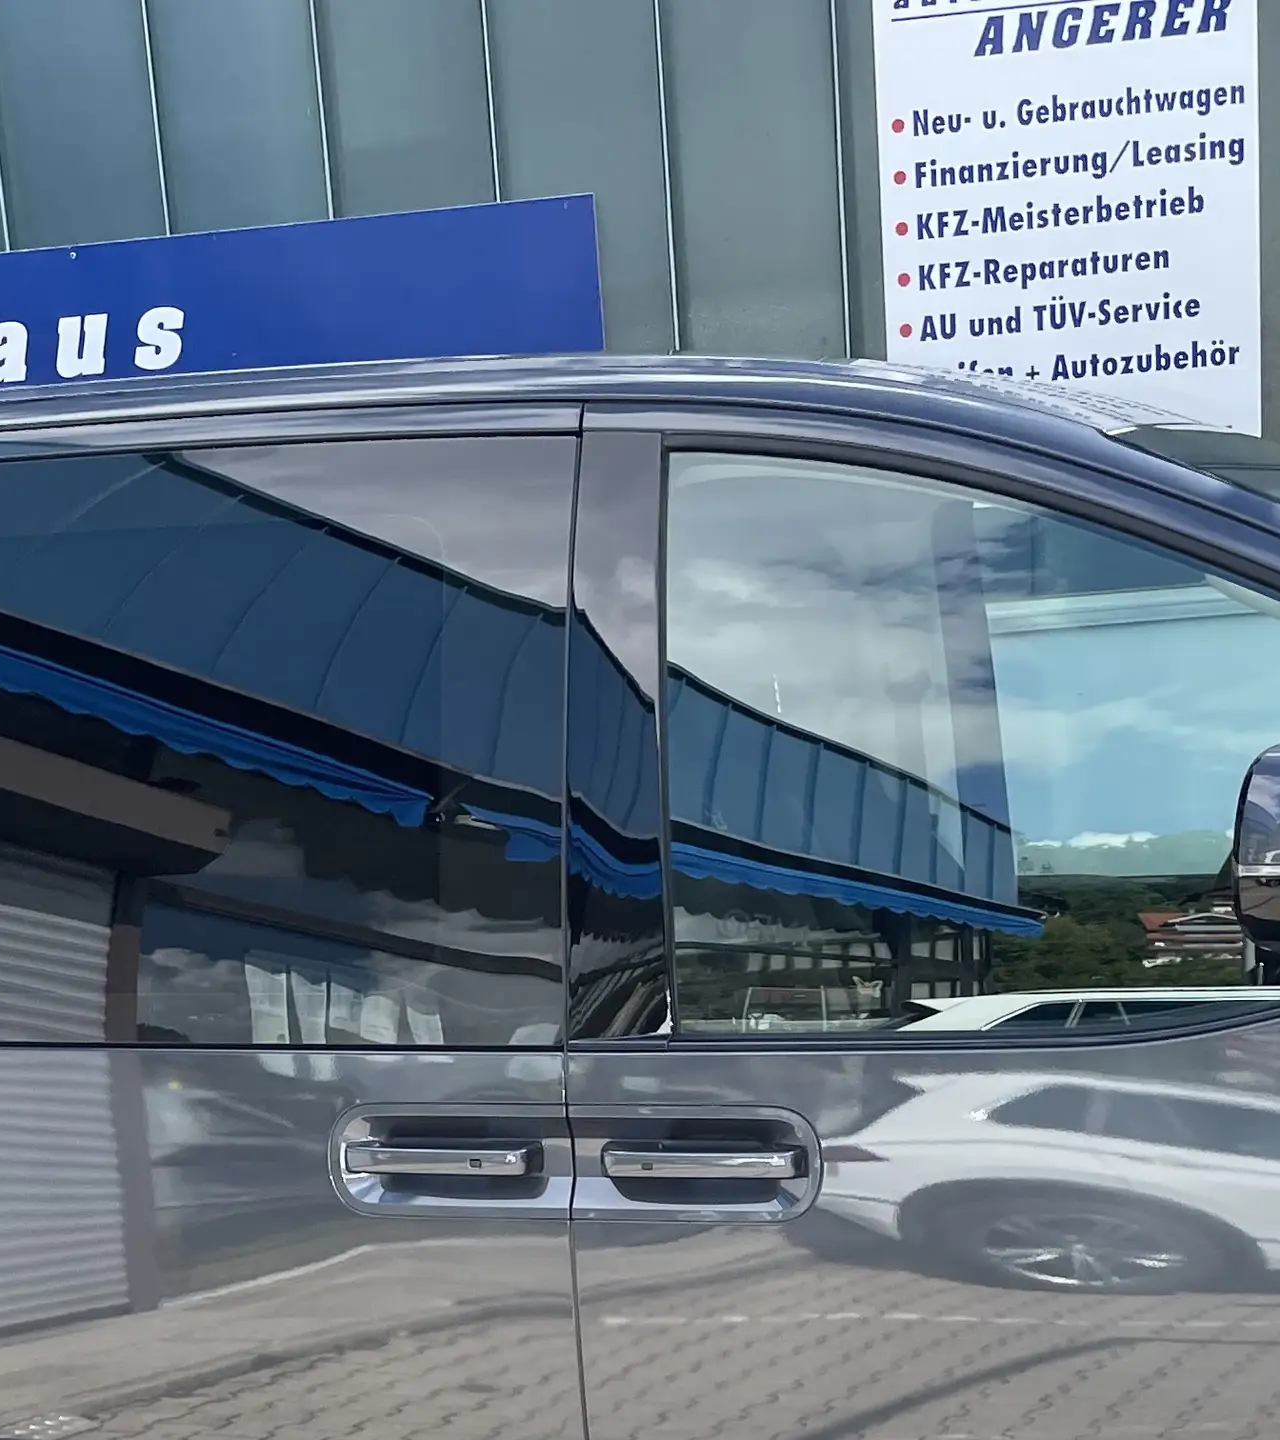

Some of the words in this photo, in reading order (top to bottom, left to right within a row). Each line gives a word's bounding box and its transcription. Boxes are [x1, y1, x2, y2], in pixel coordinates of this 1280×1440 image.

[973, 0, 1231, 57] ANGERER
[912, 109, 971, 137] Neu-
[981, 110, 1006, 131] u.
[1016, 83, 1246, 125] Gebrauchtwagen
[914, 132, 1246, 189] Finanzierung/Leasing
[916, 186, 1206, 241] KFZ-Meisterbetrieb
[918, 248, 1171, 291] KFZ-Reparaturen
[919, 313, 957, 342] AU
[969, 305, 1021, 337] und
[1033, 292, 1202, 333] TÜV-Service
[1051, 339, 1241, 381] Autozubehör
